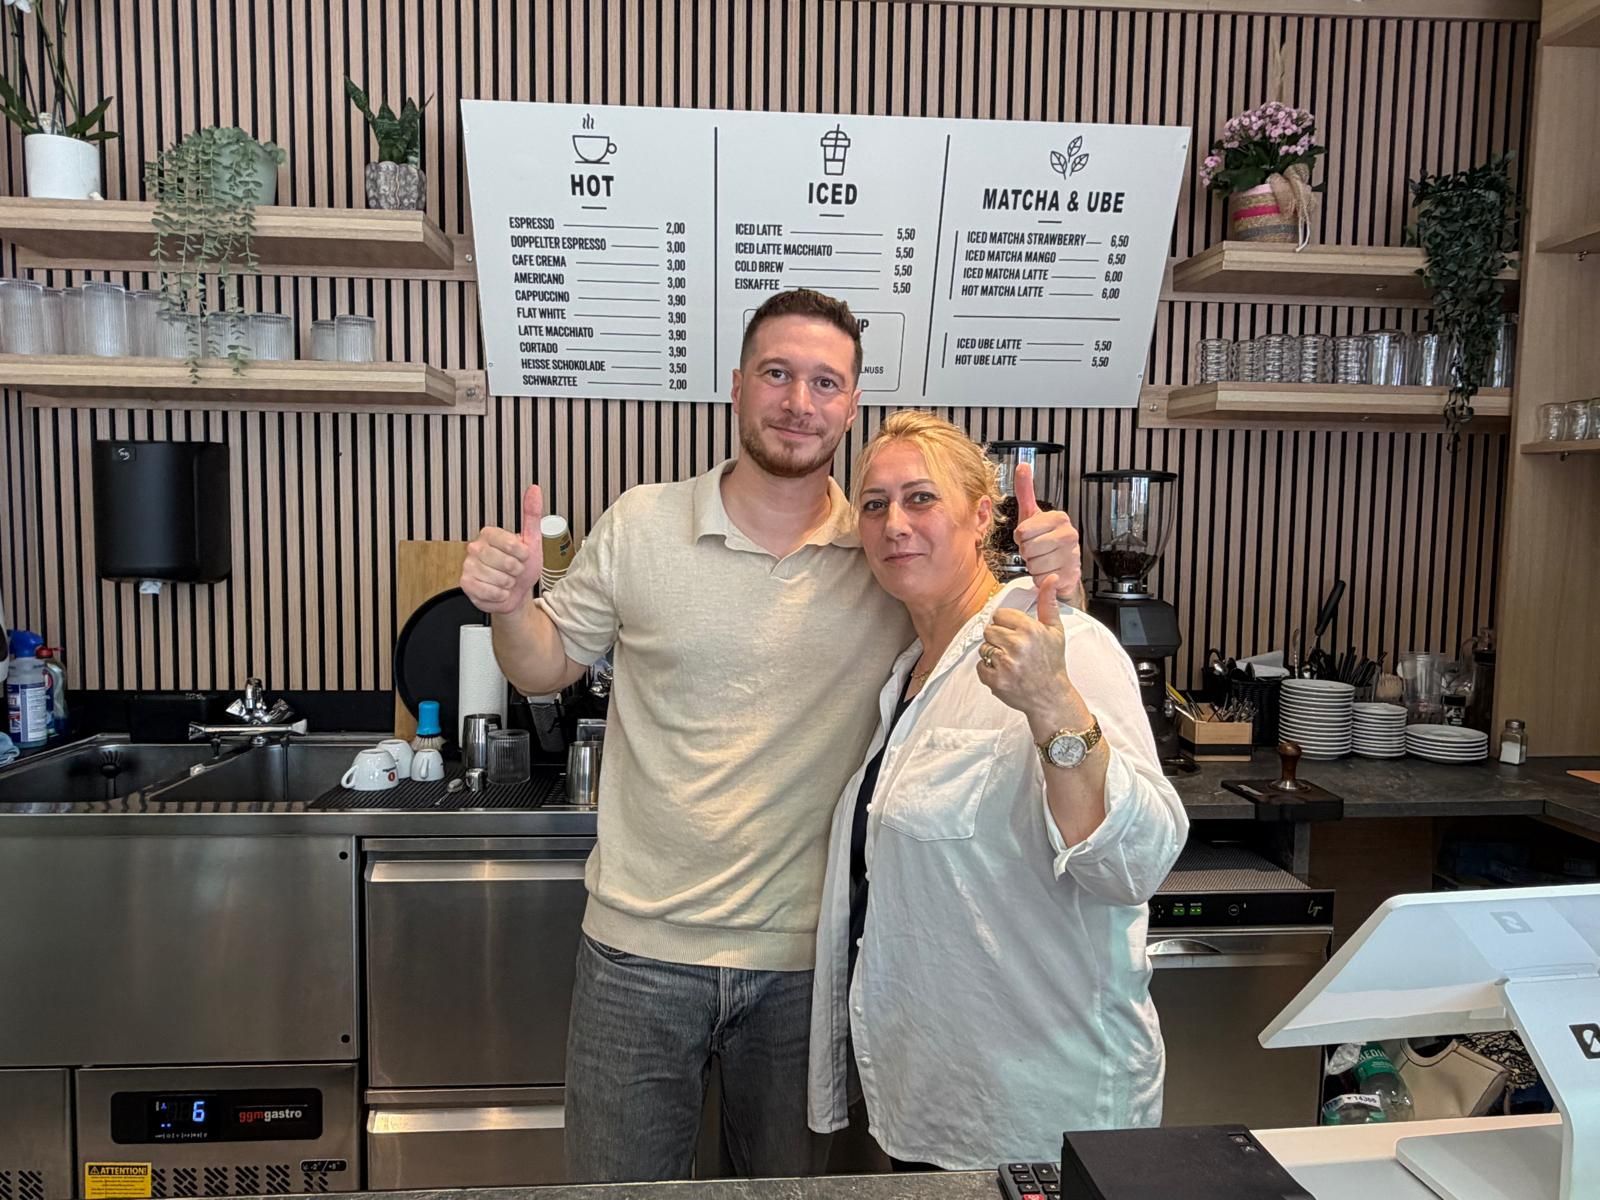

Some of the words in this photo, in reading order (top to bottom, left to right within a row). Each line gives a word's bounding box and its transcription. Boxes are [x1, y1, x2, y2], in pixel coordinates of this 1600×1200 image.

[570, 174, 614, 197] HOT
[808, 182, 857, 205] ICED
[983, 188, 1059, 211] MATCHA
[1067, 191, 1079, 212] &
[1087, 191, 1125, 213] UBE
[509, 217, 554, 230] ESPRESSO
[666, 222, 685, 235] 2,00
[736, 223, 755, 235] ICED
[757, 224, 782, 236] LATTE
[897, 228, 915, 241] 5,50
[511, 235, 560, 249] DOPPELTER
[562, 237, 606, 251] ESPRESSO
[667, 241, 685, 254] 3,00
[967, 231, 987, 243] ICED
[989, 232, 1025, 245] MATCHA
[1027, 233, 1086, 246] STRAWBERRY
[1111, 235, 1129, 248] 6,50
[735, 242, 754, 254] ICED
[756, 243, 782, 255] LATTE
[784, 244, 832, 256] MACCHIATO
[896, 247, 914, 260] 5,50
[965, 250, 985, 261] ICED
[987, 250, 1022, 262] MATCHA
[1025, 251, 1056, 263] MANGO
[1108, 253, 1126, 265] 6,50
[512, 254, 535, 266] CAFE
[536, 255, 566, 267] CREMA
[667, 259, 685, 272] 3,00
[735, 260, 757, 272] COLD
[759, 261, 784, 273] BREW
[894, 265, 912, 277] 5,50
[514, 272, 564, 285] AMERICANO
[667, 277, 686, 289] 3,00
[963, 267, 983, 279] ICED
[985, 268, 1020, 280] MATCHA
[1022, 269, 1049, 280] LATTE
[1105, 271, 1123, 283] 6,00
[735, 278, 780, 290] EISKAFFEE
[893, 282, 911, 295] 5,50
[961, 285, 979, 296] HOT
[981, 285, 1016, 297] MATCHA
[1017, 286, 1044, 297] LATTE
[1102, 288, 1120, 300] 6,00
[515, 290, 570, 302] CAPPUCCINO
[668, 294, 686, 307] 3,90
[517, 307, 537, 318] FLAT
[538, 308, 566, 319] WHITE
[668, 312, 686, 325] 3,90
[518, 325, 544, 336] LATTE
[545, 326, 593, 338] MACCHIATO
[668, 329, 686, 342] 3,90
[520, 342, 558, 353] CORTADO
[669, 346, 686, 358] 3,90
[957, 338, 976, 349] ICED
[978, 338, 995, 349] UBE
[996, 339, 1022, 350] LATTE
[1094, 340, 1112, 352] 5,50
[521, 358, 551, 370] HEISSE
[552, 359, 606, 371] SCHOKOLADE
[669, 363, 687, 374] 3,50
[955, 354, 972, 365] HOT
[973, 355, 990, 365] UBE
[992, 355, 1017, 366] LATTE
[1091, 357, 1109, 368] 5,50
[523, 375, 578, 387] SCHWARZTEE
[669, 379, 687, 391] 2,00
[192, 1101, 205, 1122] 6
[239, 1109, 302, 1123] ggmgastro
